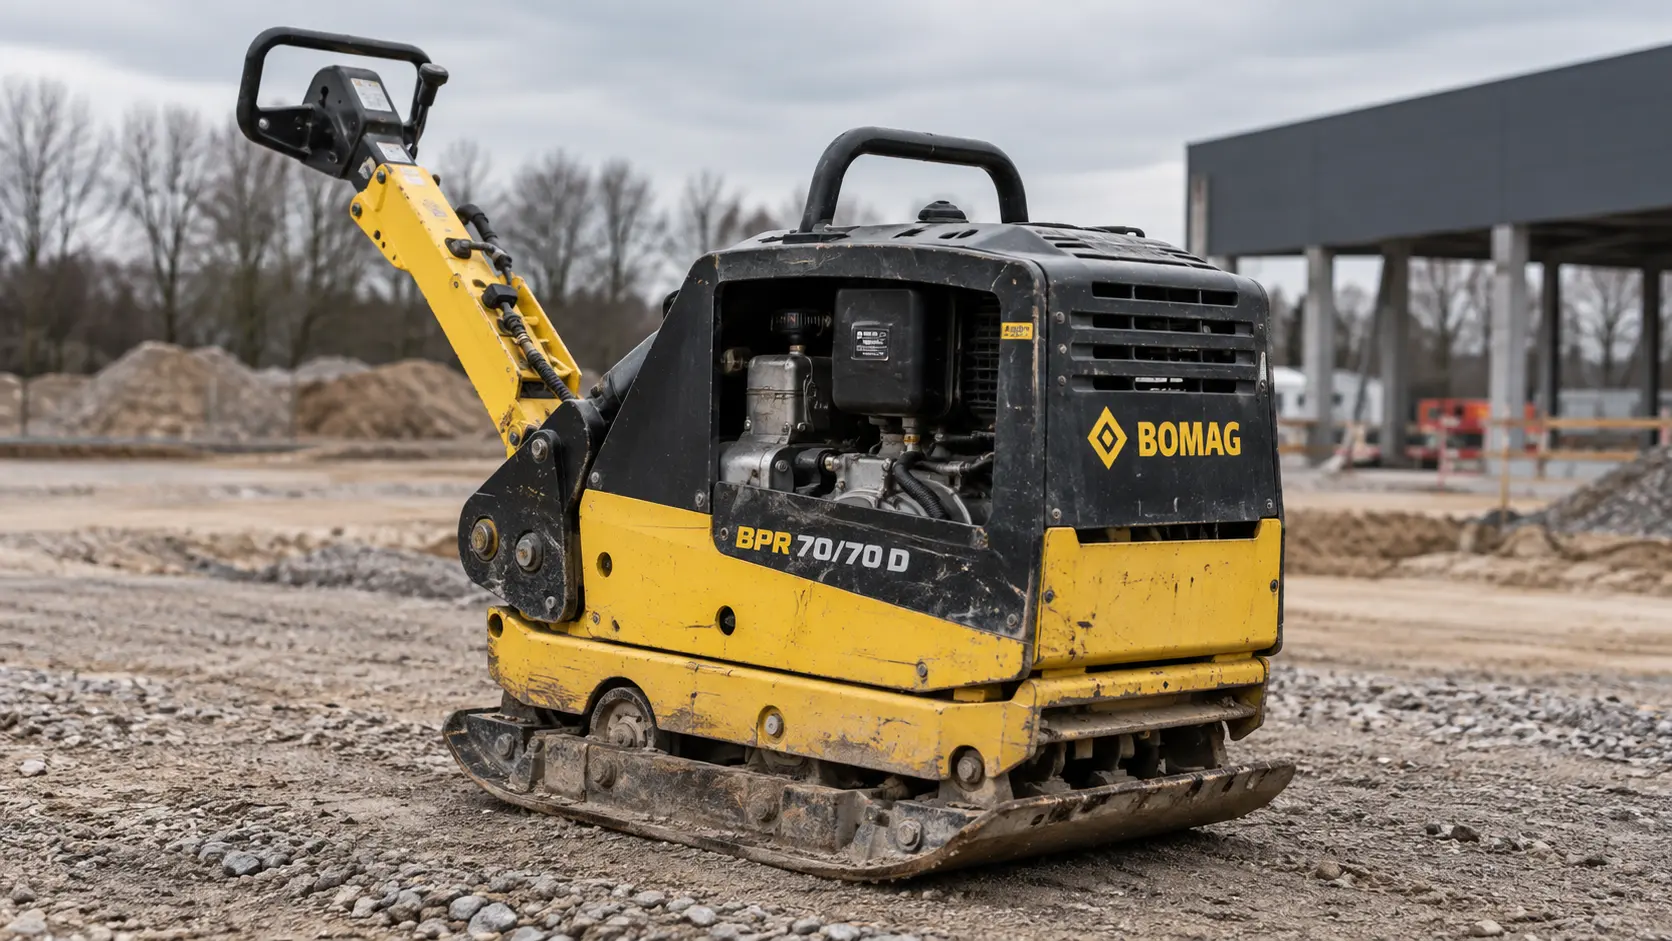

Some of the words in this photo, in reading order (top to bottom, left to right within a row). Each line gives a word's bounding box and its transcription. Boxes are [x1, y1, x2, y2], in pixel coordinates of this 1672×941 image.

[1137, 421, 1241, 457] BOMAG
[735, 525, 792, 555] BPR
[797, 534, 883, 569] 70/70
[887, 547, 910, 573] D
